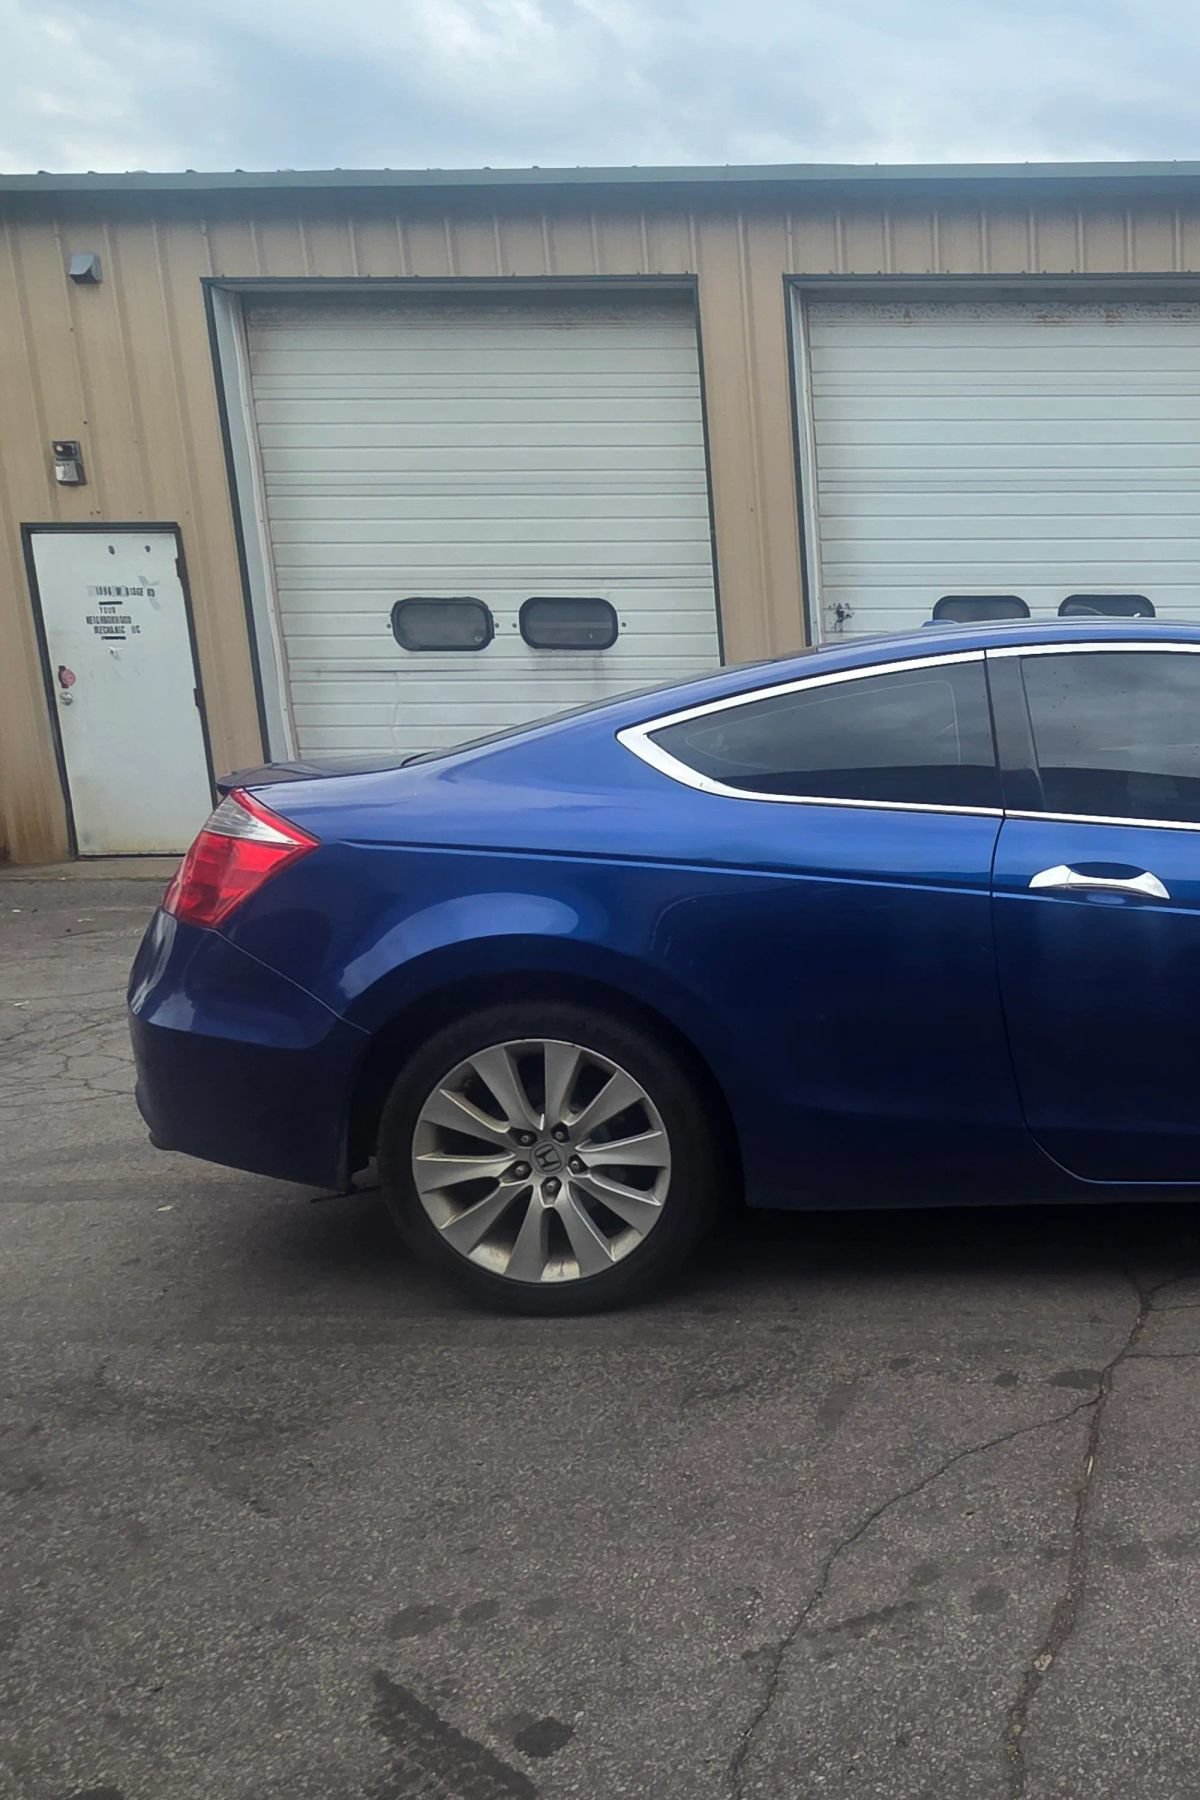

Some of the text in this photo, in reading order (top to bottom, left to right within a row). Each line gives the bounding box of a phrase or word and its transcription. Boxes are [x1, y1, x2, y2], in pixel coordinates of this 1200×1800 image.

[99, 606, 116, 614] YOUR
[85, 615, 132, 624] NEIGHBORHOOD
[94, 625, 125, 634] MECHANIC
